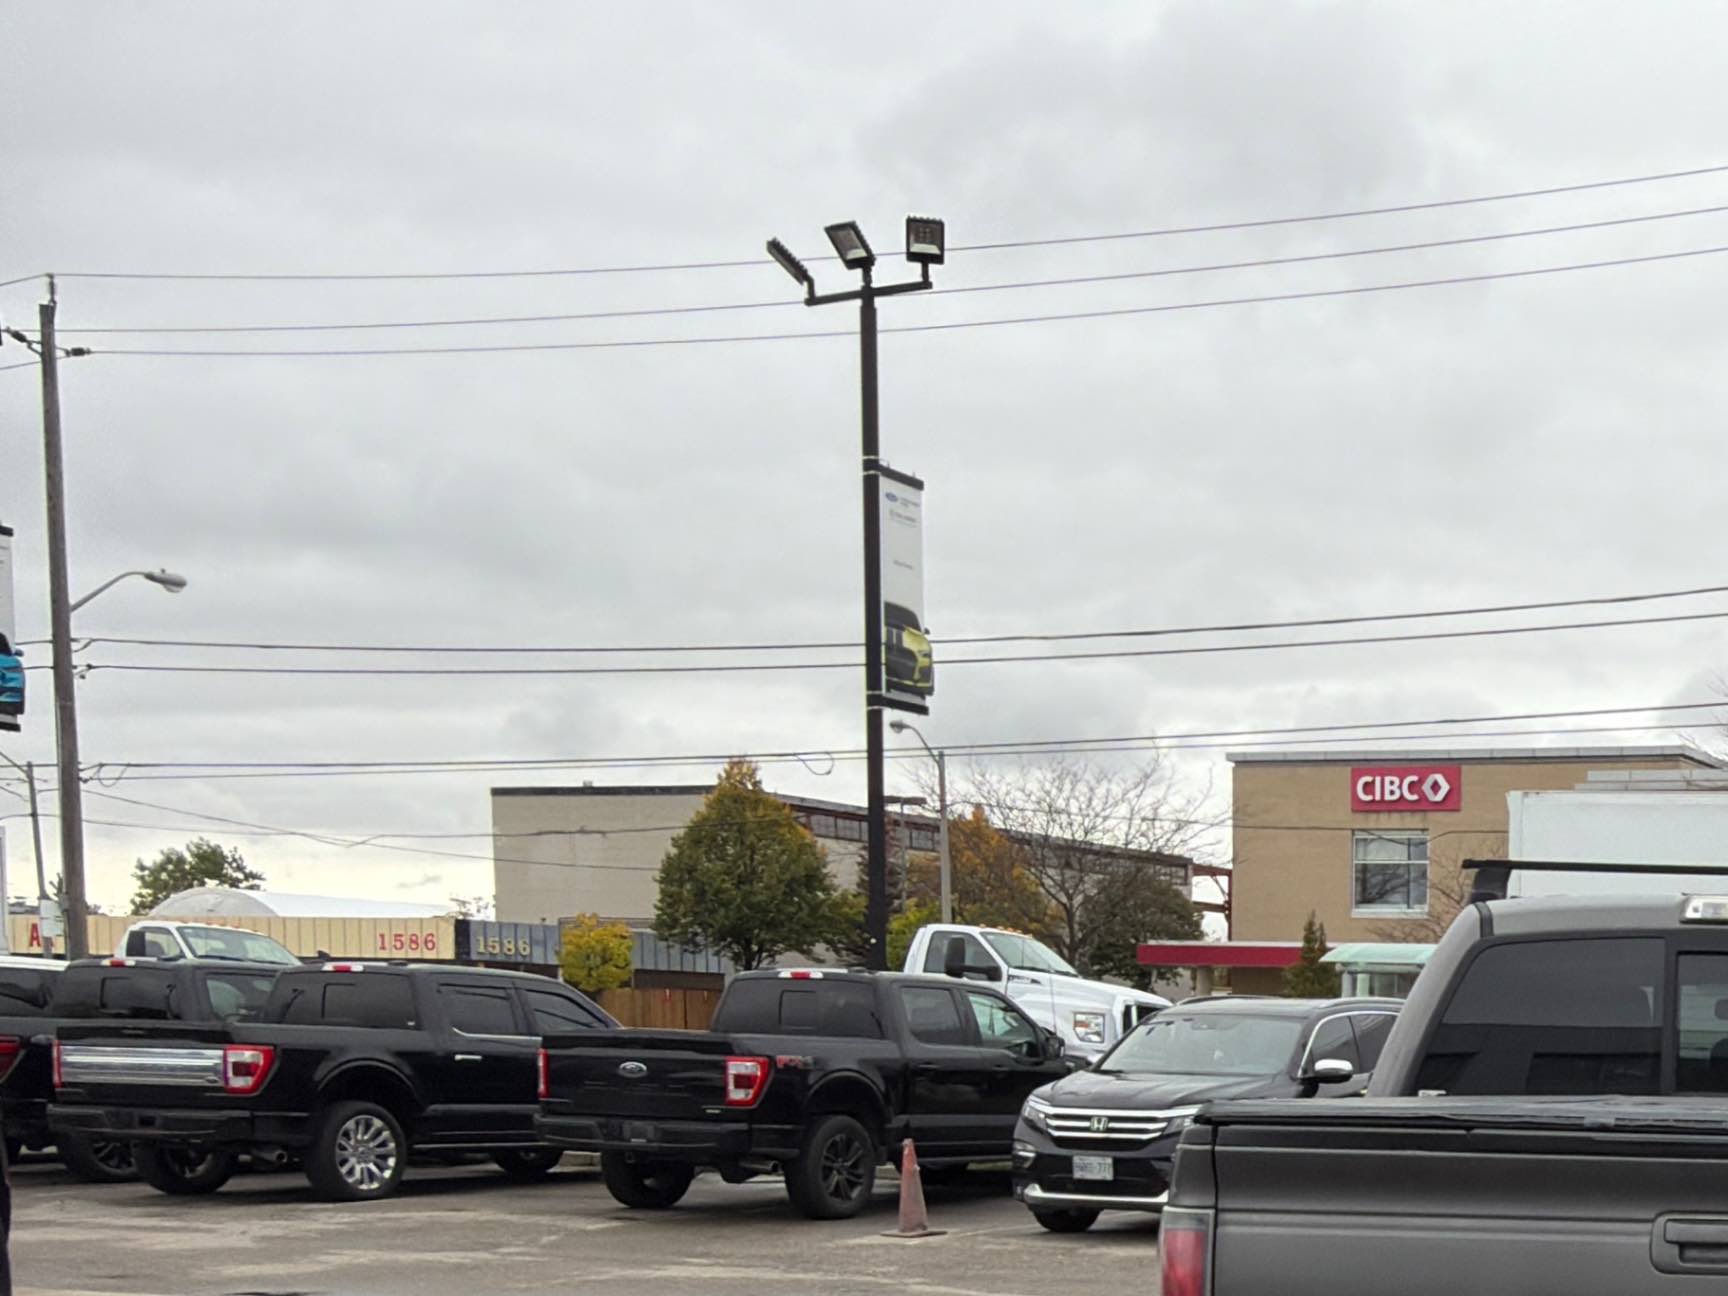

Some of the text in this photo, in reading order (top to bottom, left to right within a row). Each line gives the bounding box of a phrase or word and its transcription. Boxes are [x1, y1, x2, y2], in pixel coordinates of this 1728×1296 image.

[1356, 775, 1419, 802] CIBC
[378, 933, 436, 951] 1586
[477, 937, 531, 956] 1586
